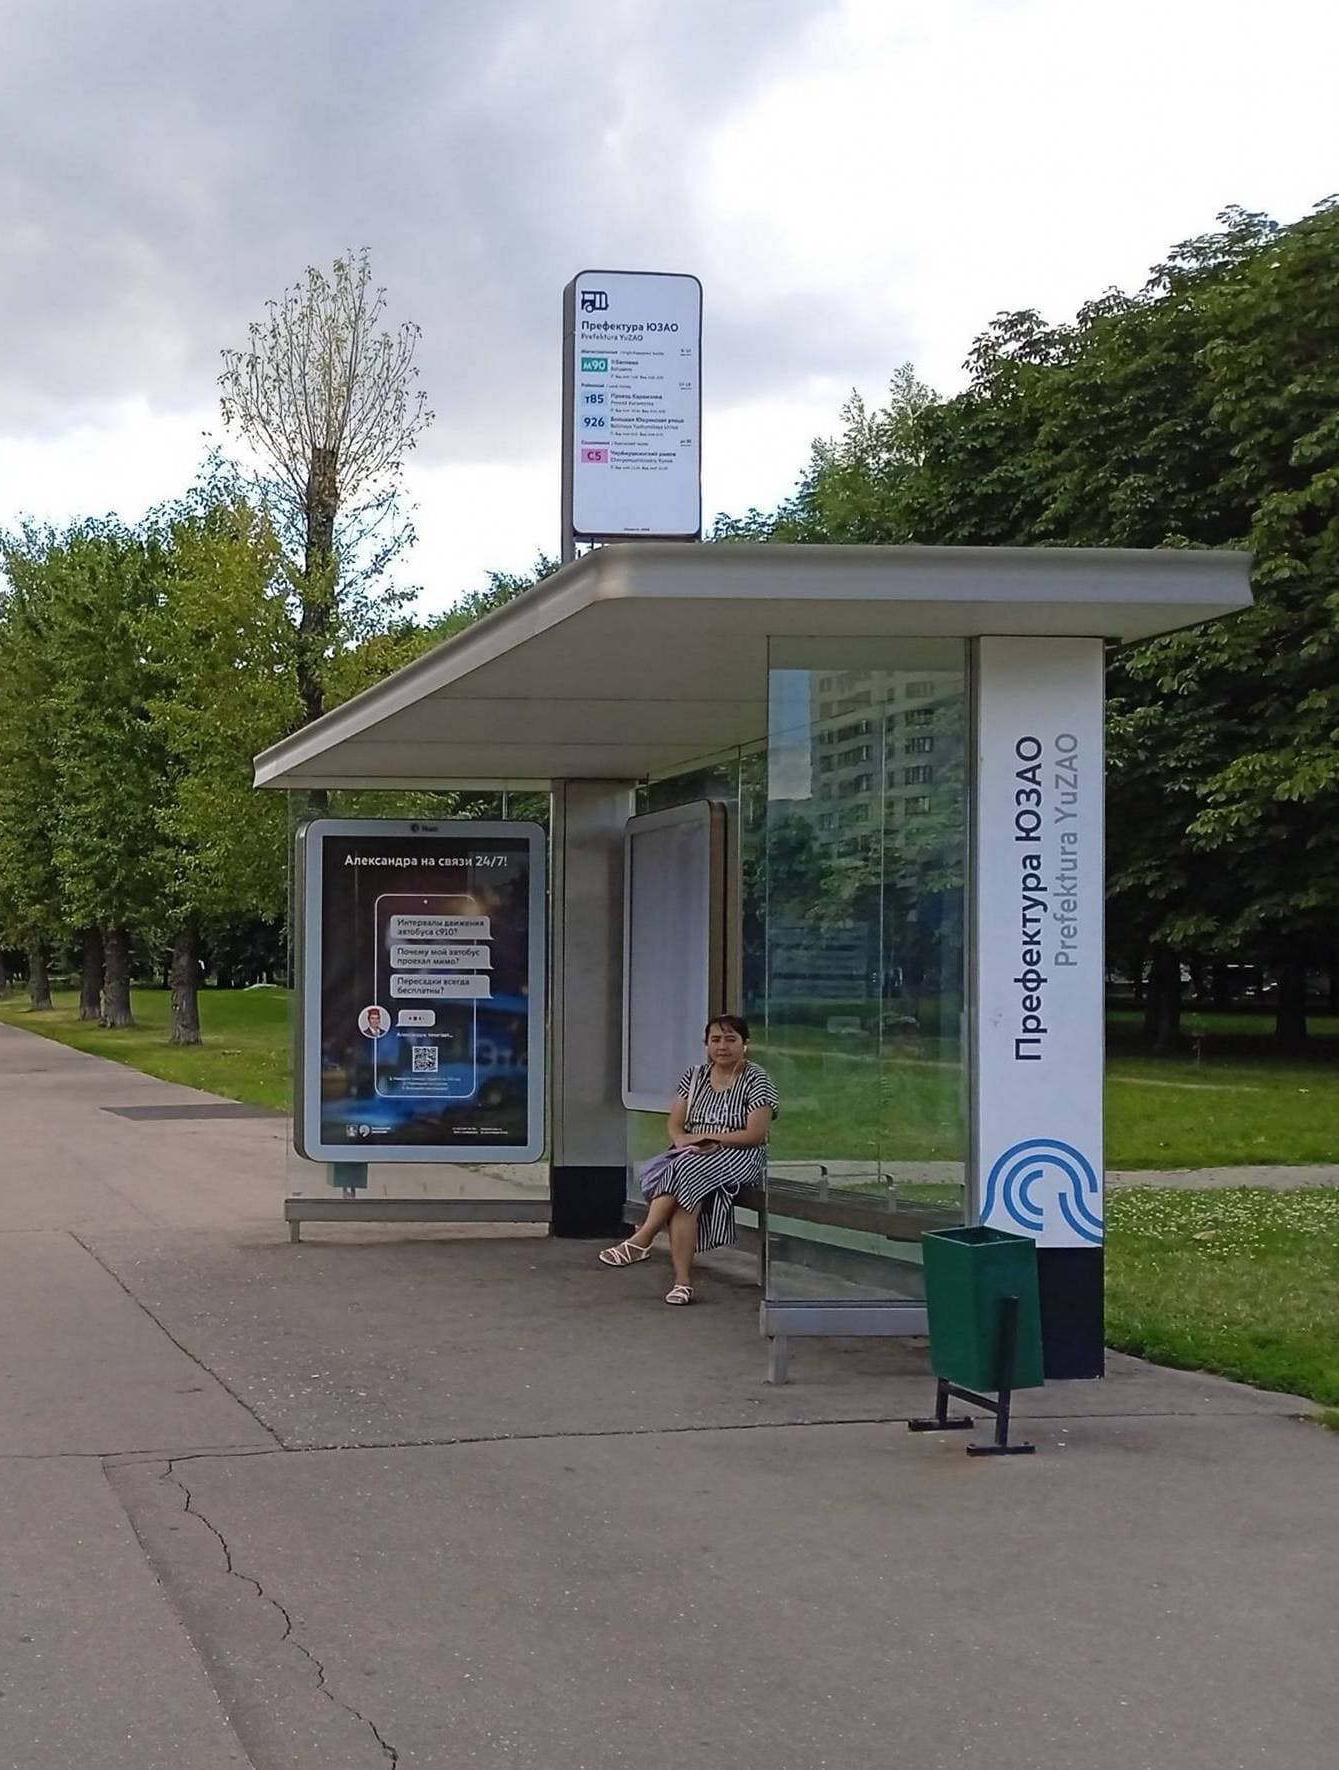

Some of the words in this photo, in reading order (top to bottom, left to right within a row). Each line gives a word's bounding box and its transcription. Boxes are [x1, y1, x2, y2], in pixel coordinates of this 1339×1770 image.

[581, 320, 644, 333] Префектура
[646, 322, 679, 332] ЮЗАО
[584, 417, 605, 427] 926
[1055, 733, 1078, 824] YuZAO
[1015, 736, 1042, 842] ЮЗАО
[344, 854, 418, 868] Александра
[421, 857, 436, 866] на
[438, 857, 472, 867] связи
[475, 855, 508, 868] 24/7!
[1054, 832, 1078, 966] Prefektura
[398, 947, 429, 957] Почему
[449, 948, 480, 956] автобус
[1014, 854, 1048, 1060] Префектура
[398, 977, 442, 985] Пересадки
